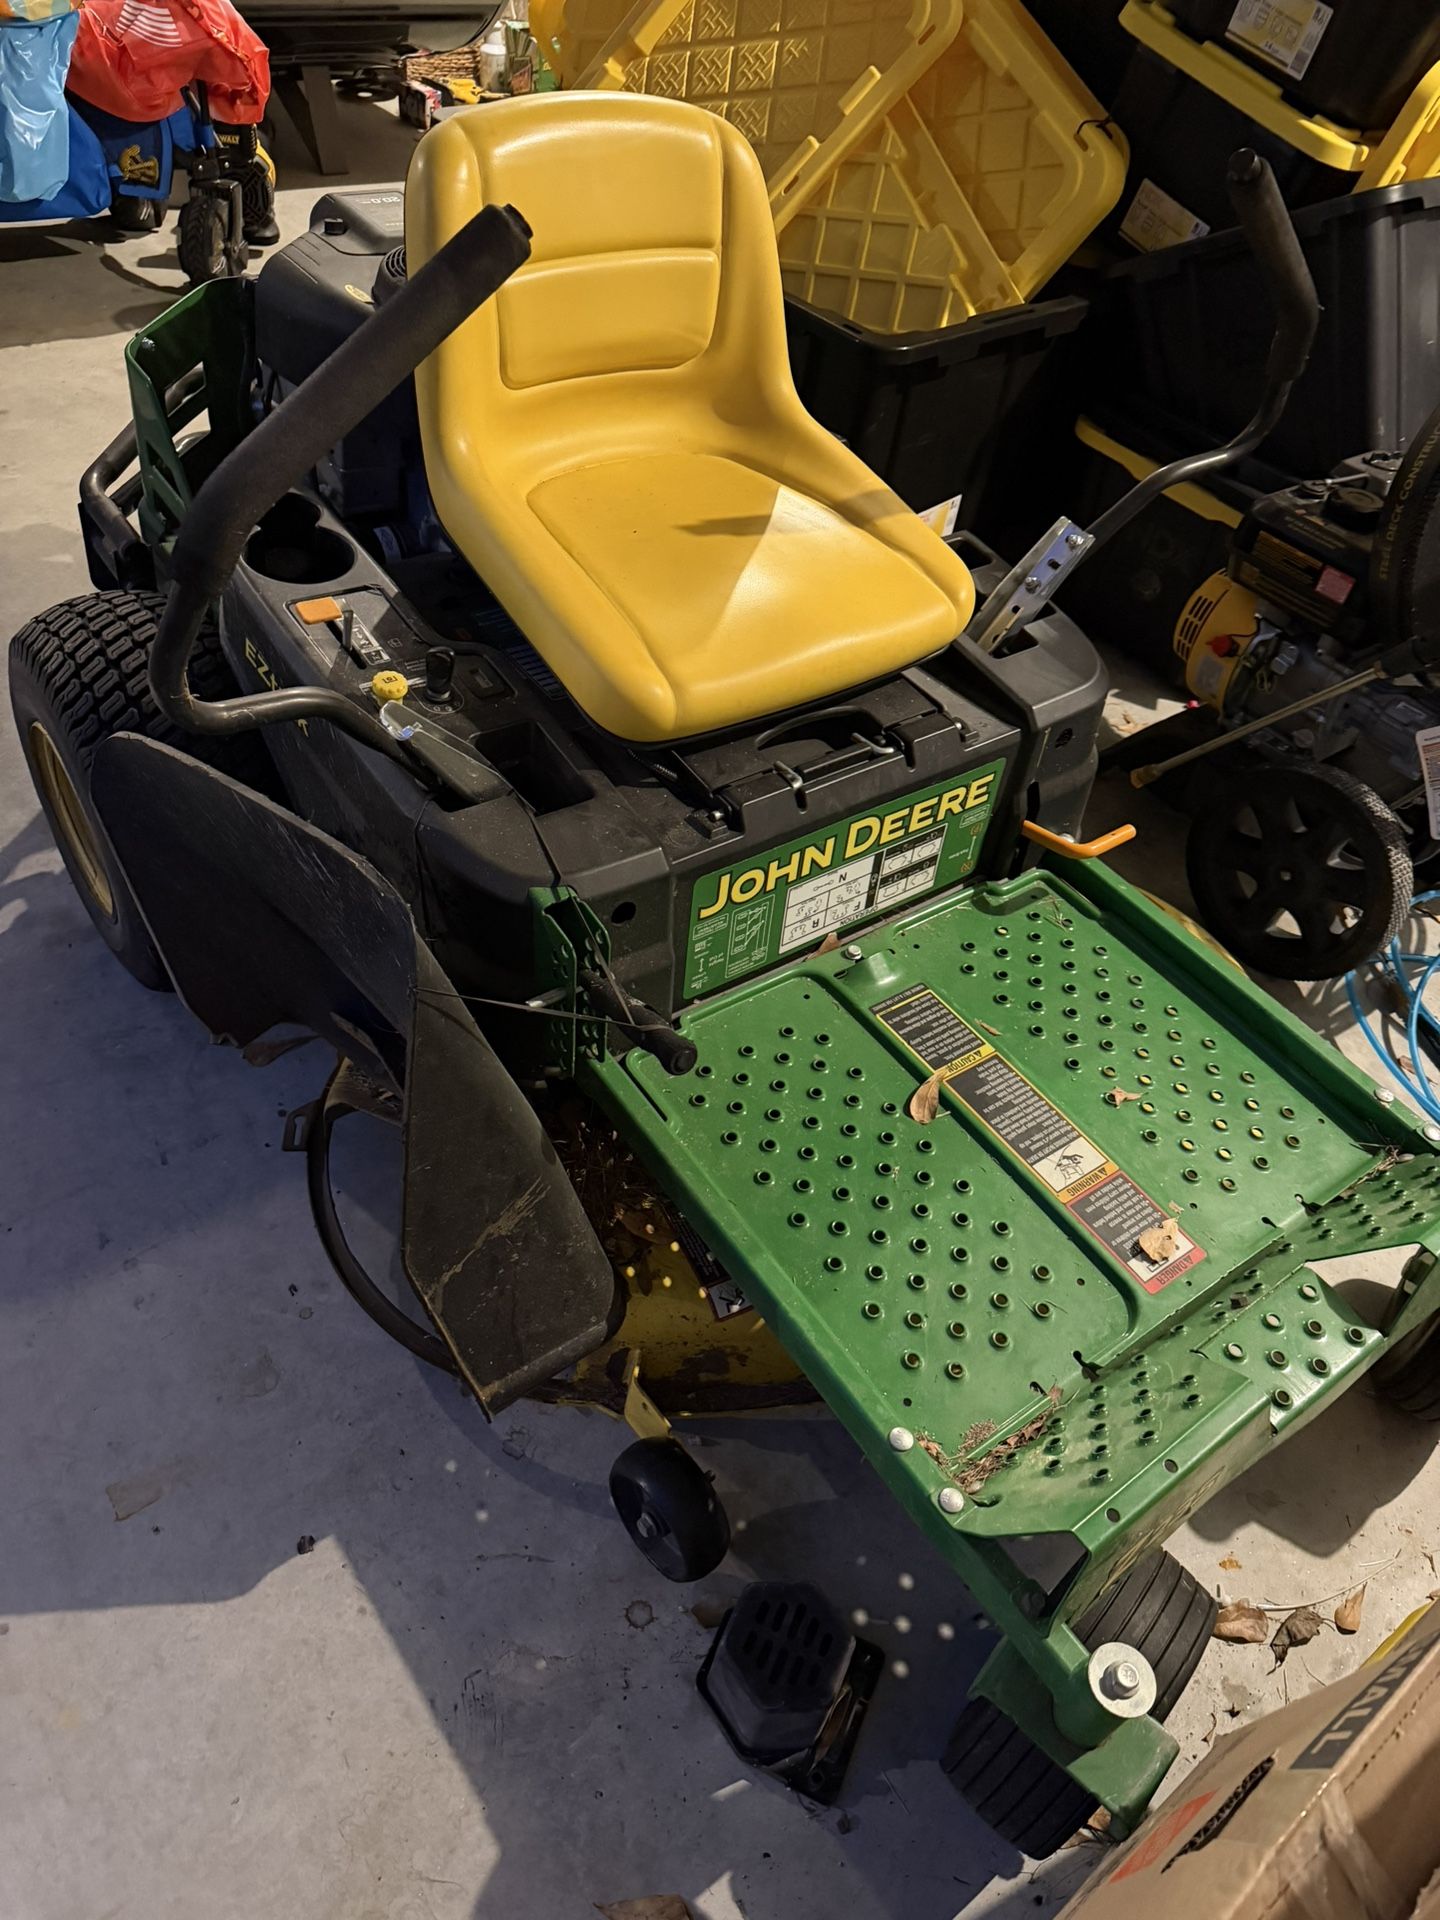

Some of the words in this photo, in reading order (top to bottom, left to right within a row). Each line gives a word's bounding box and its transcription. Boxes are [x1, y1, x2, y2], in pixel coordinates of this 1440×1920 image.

[219, 134, 240, 144] WALT
[1386, 504, 1404, 541] DECK
[699, 836, 836, 919] JOHN
[844, 773, 996, 860] DEERE
[838, 872, 848, 883] N
[839, 904, 879, 926] OPERATION
[944, 1053, 976, 1073] CAUTION
[1065, 1171, 1102, 1197] WARNING
[1155, 1259, 1187, 1285] DANGER
